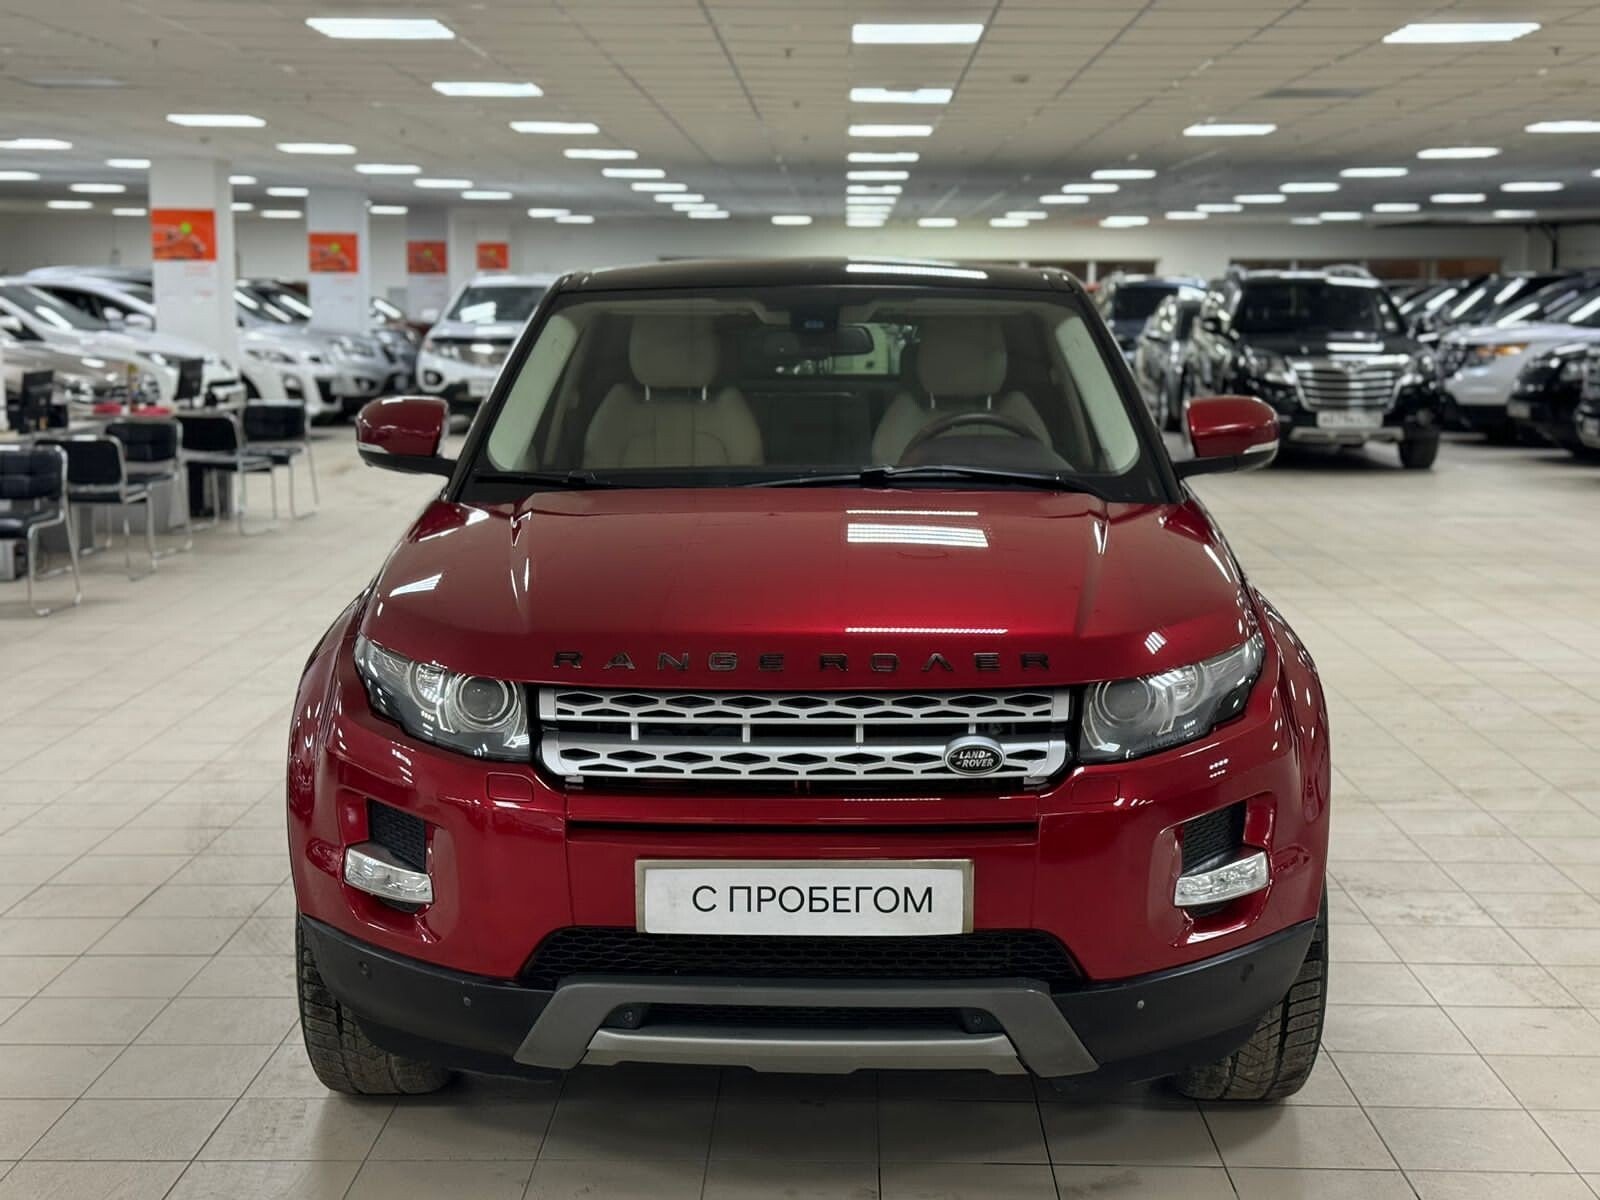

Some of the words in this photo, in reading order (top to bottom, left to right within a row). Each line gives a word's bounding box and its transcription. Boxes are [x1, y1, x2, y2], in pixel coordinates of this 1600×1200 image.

[552, 652, 785, 671] RANGE
[959, 751, 986, 759] LAND
[962, 759, 994, 767] ROVER
[692, 885, 717, 912] С
[729, 886, 933, 913] ПРОБЕГОМ
